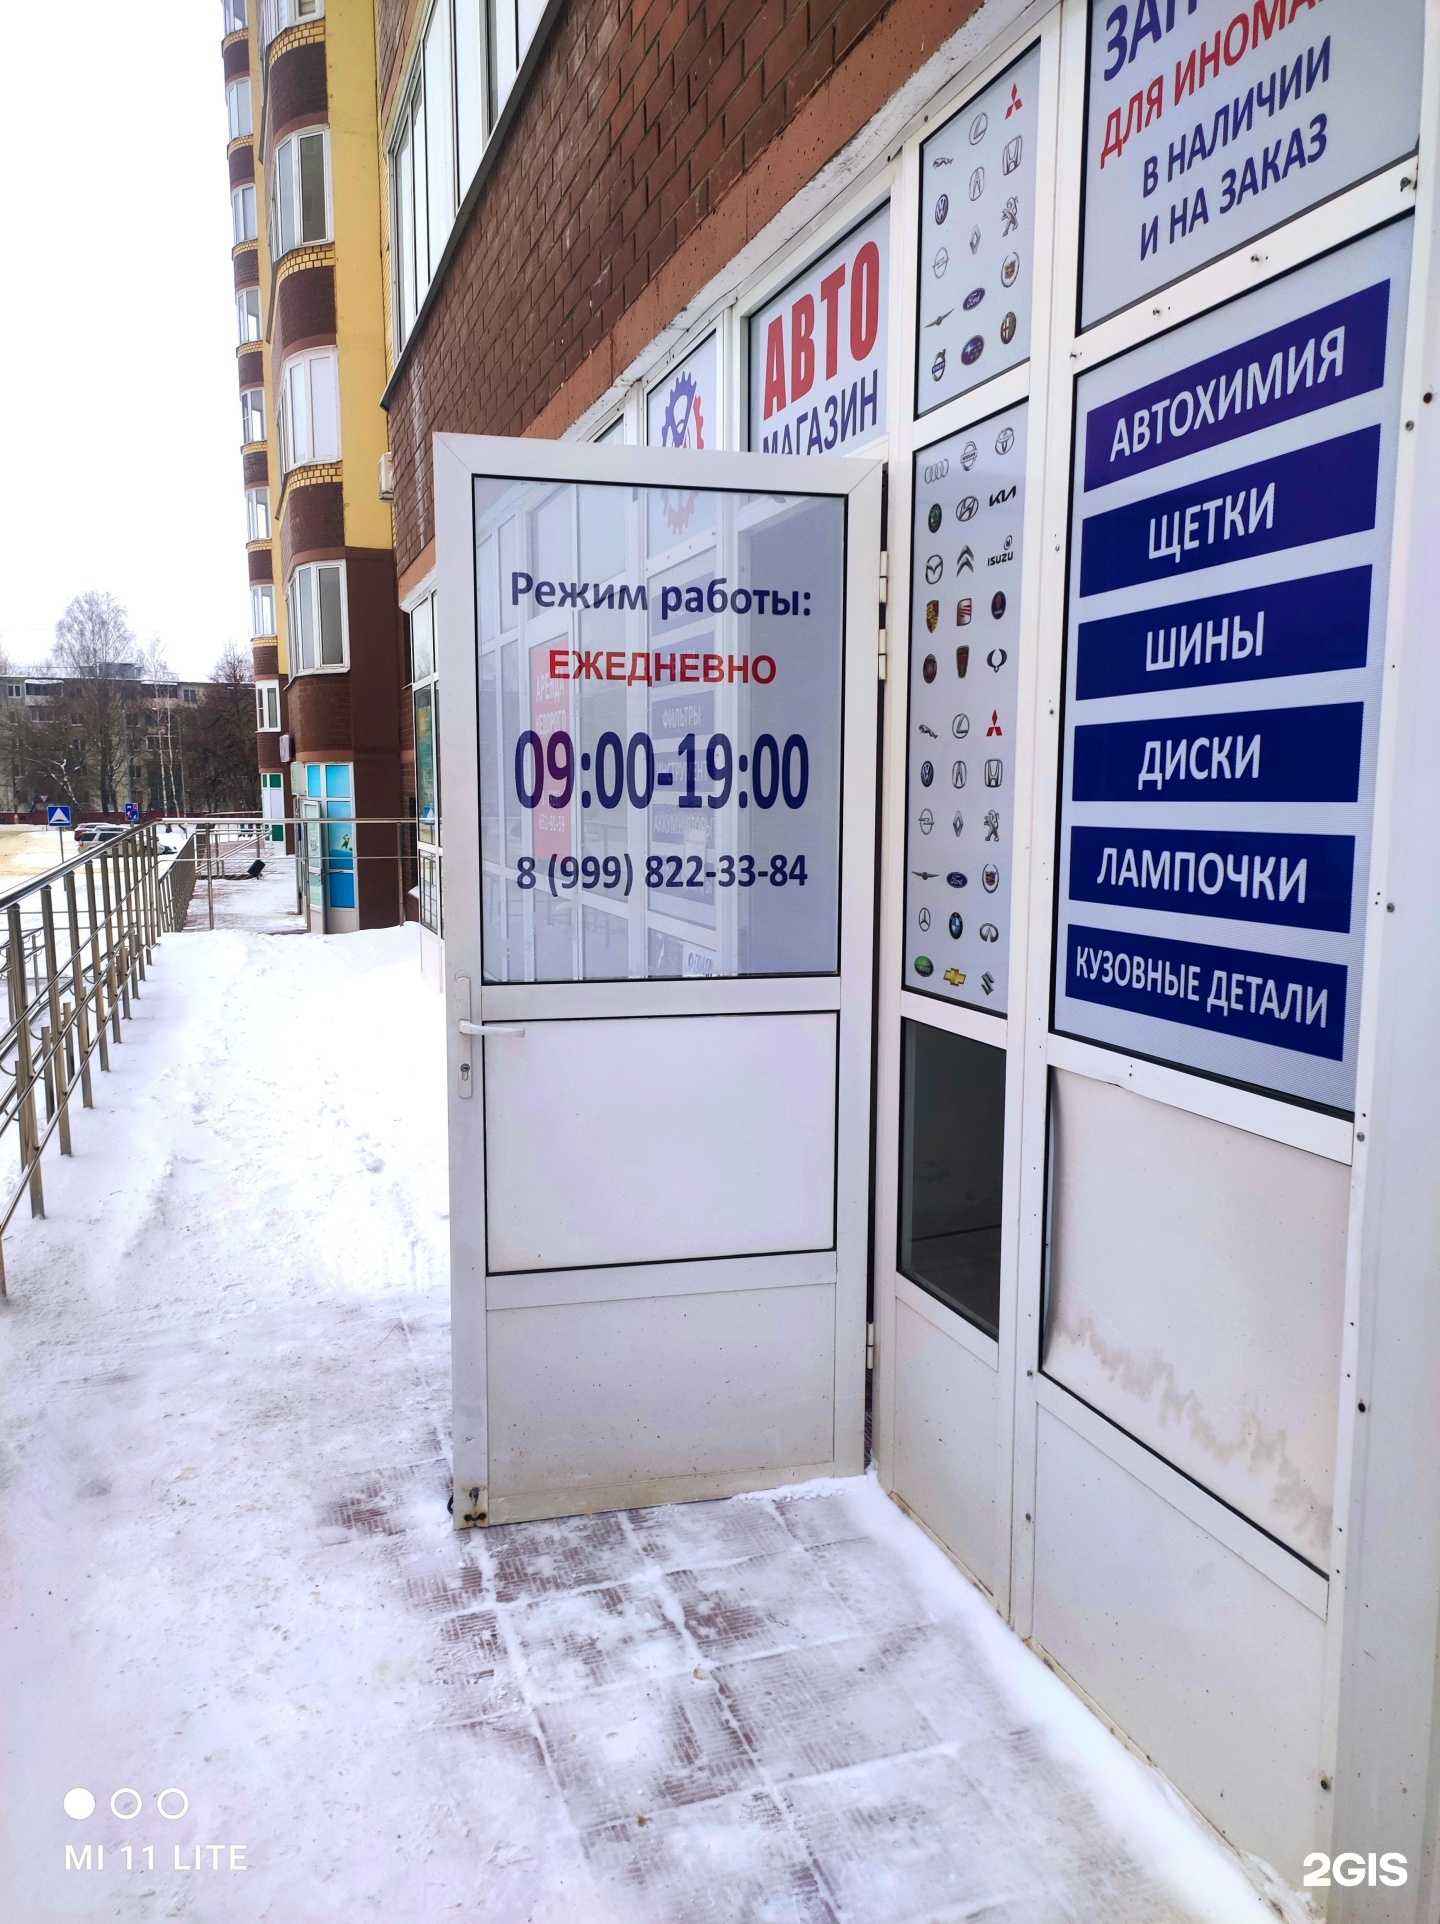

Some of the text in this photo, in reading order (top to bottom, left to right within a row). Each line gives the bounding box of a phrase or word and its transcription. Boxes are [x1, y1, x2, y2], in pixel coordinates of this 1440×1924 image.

[1100, 0, 1323, 169] ДЛЯ ИНОМ
[1143, 35, 1331, 199] В НАЛИЧИИ
[1140, 113, 1328, 261] И НА ЗАКАЗ
[763, 240, 880, 421] АВТО
[1108, 325, 1346, 462] АВТОХИМИЯ
[987, 550, 1014, 567] ISUZU
[1148, 481, 1276, 563] ЩЕТКИ
[511, 571, 812, 620] Режим работы:
[549, 649, 777, 687] ЕЖЕДНЕВНО
[1145, 610, 1265, 672] ШИНЫ
[514, 729, 809, 810] 09:00-19:00
[1138, 734, 1261, 791] ДИСКИ
[516, 853, 809, 898] 8 (999) 822-33-84
[1096, 847, 1308, 904] ЛАМПОЧКИ
[1076, 945, 1328, 1029] КУЗОВНЫЕ ДЕТАЛИ
